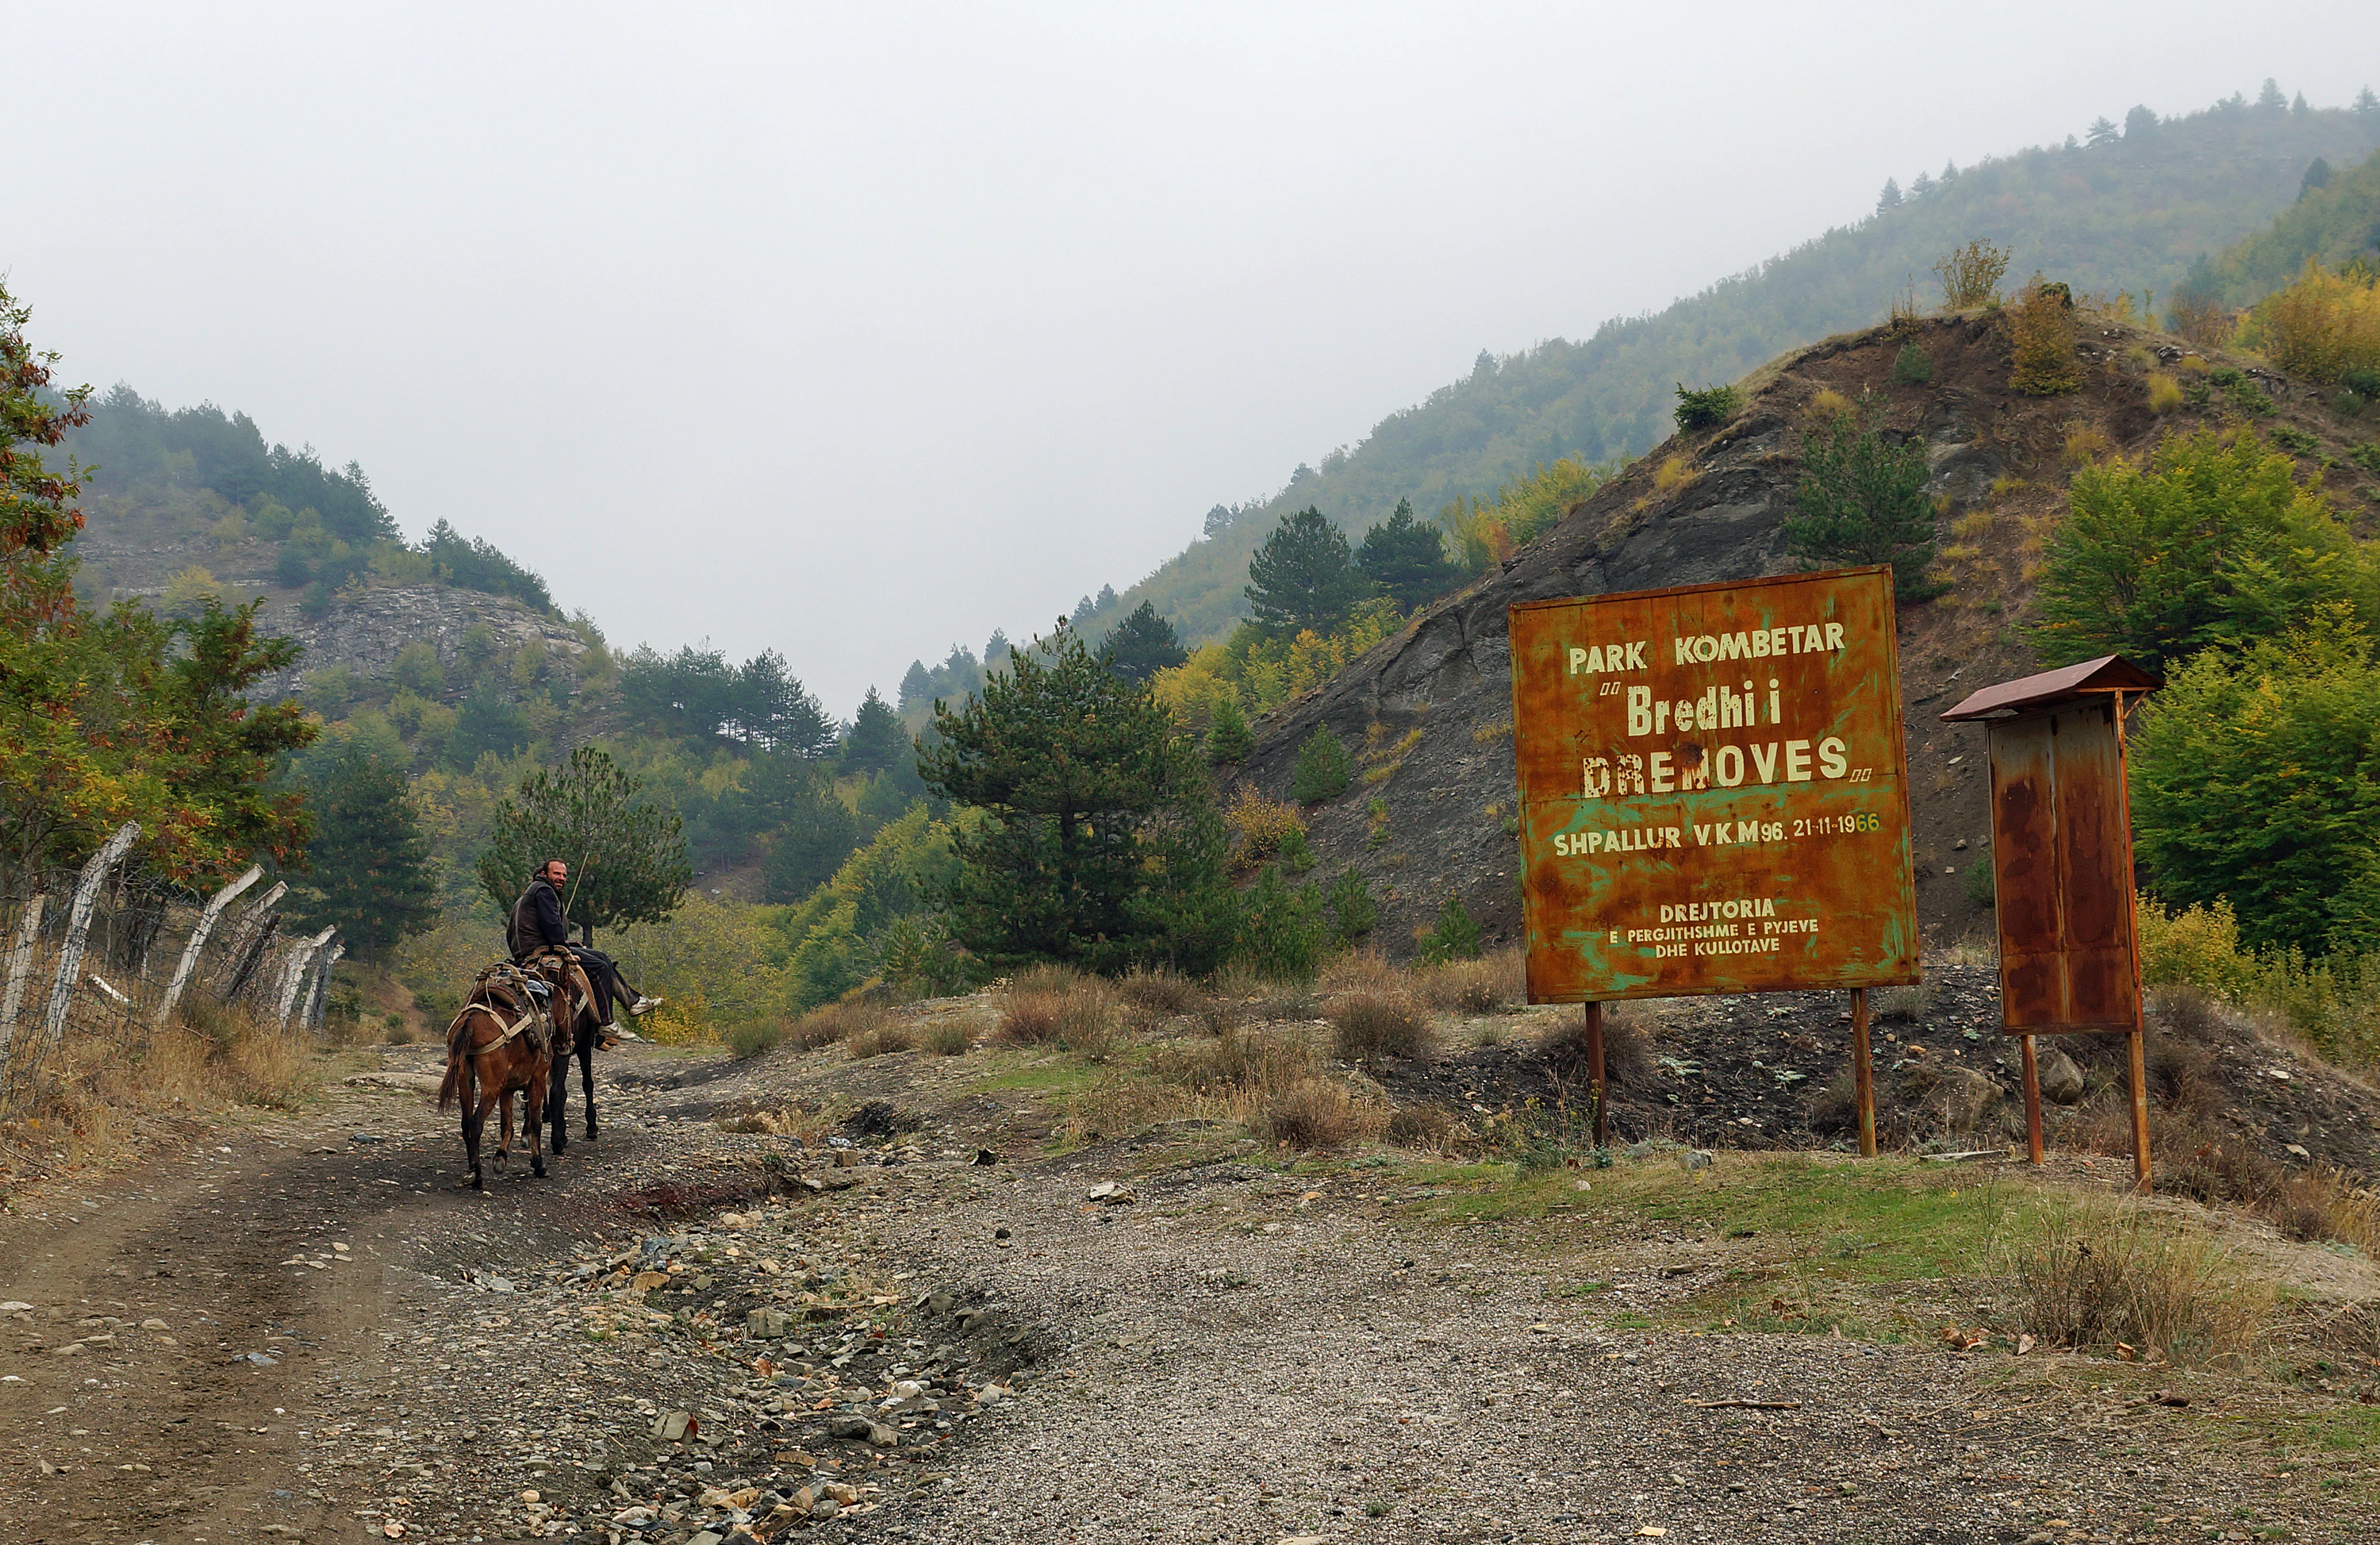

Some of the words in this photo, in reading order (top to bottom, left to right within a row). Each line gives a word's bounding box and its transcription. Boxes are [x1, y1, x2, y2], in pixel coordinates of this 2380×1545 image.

[1569, 641, 1648, 674] PARK
[1675, 622, 1845, 666] KOMBETAR
[1769, 678, 1781, 724] i
[1553, 826, 1682, 856] SHPALLUR
[1793, 812, 1880, 838] 21-11-1966
[1660, 898, 1775, 924] DREJTORIA
[1610, 931, 1618, 944] E
[1628, 924, 1739, 943] PERGJITHSHME
[1748, 923, 1756, 936] E
[1764, 919, 1819, 935] PYJEVE
[1656, 944, 1687, 959] DHE
[1695, 938, 1780, 955] KULLOTAVE
